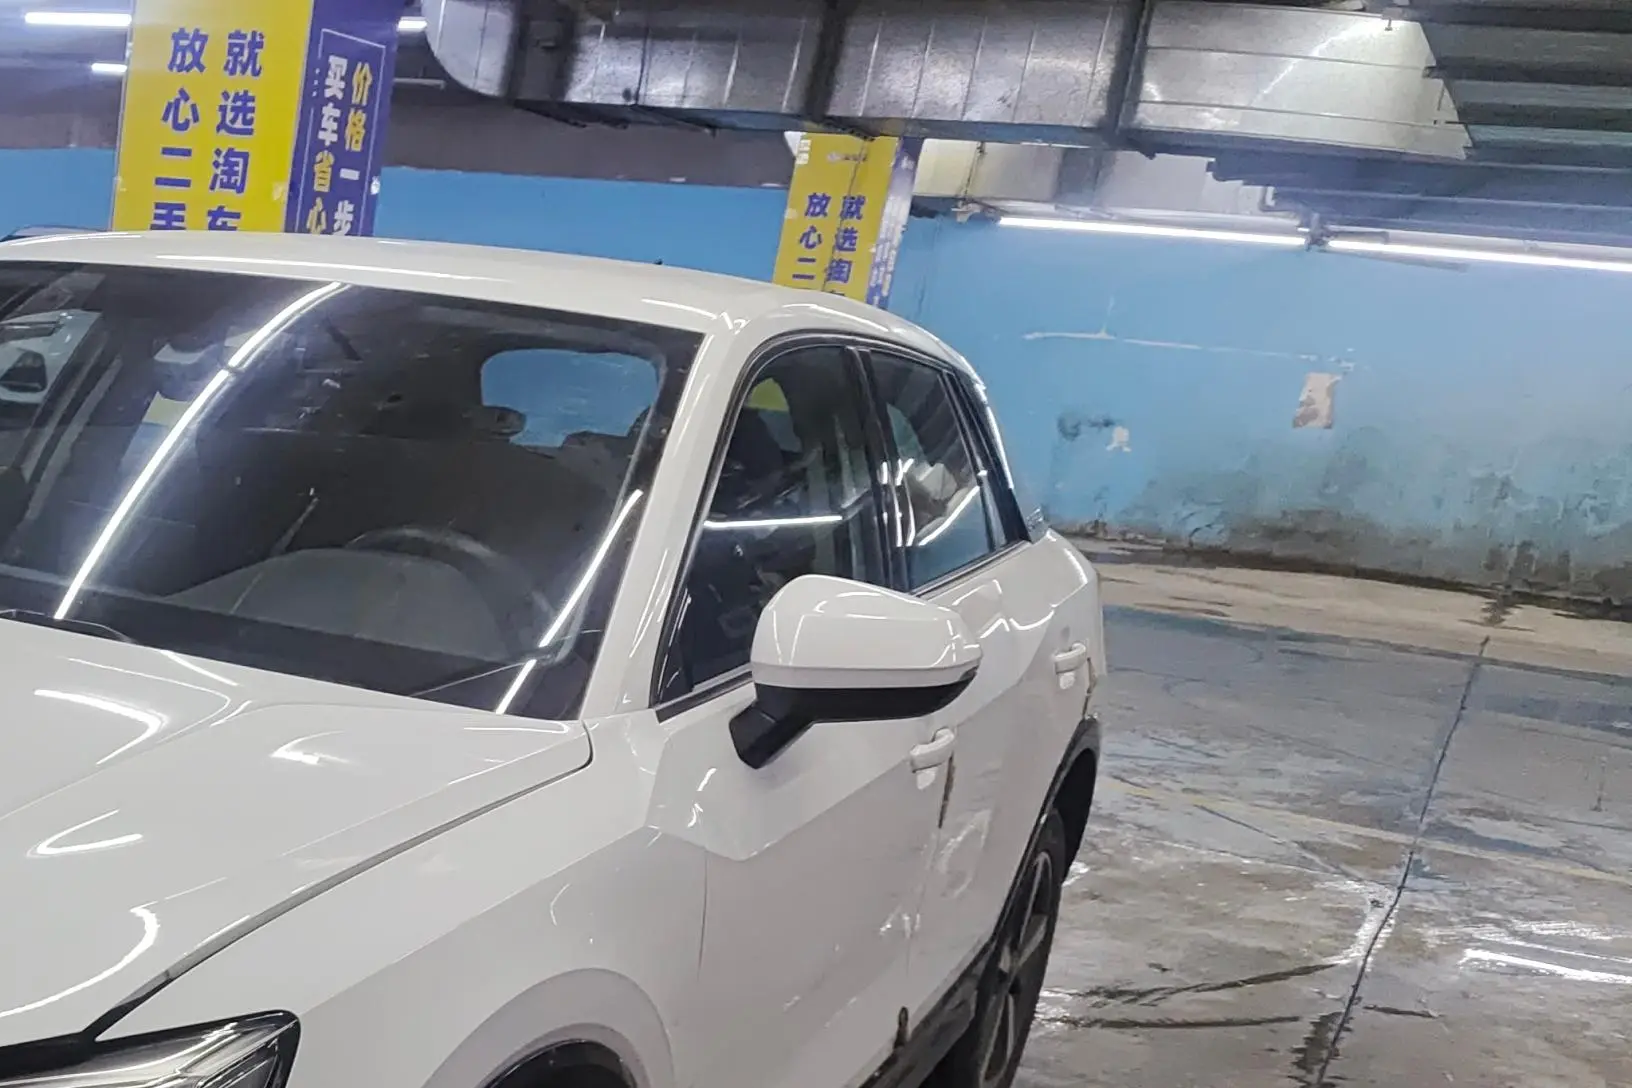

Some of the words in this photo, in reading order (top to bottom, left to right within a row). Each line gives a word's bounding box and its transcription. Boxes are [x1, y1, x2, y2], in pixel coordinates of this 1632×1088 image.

[306, 55, 348, 234] 买车省心
[824, 195, 866, 296] 就选淘
